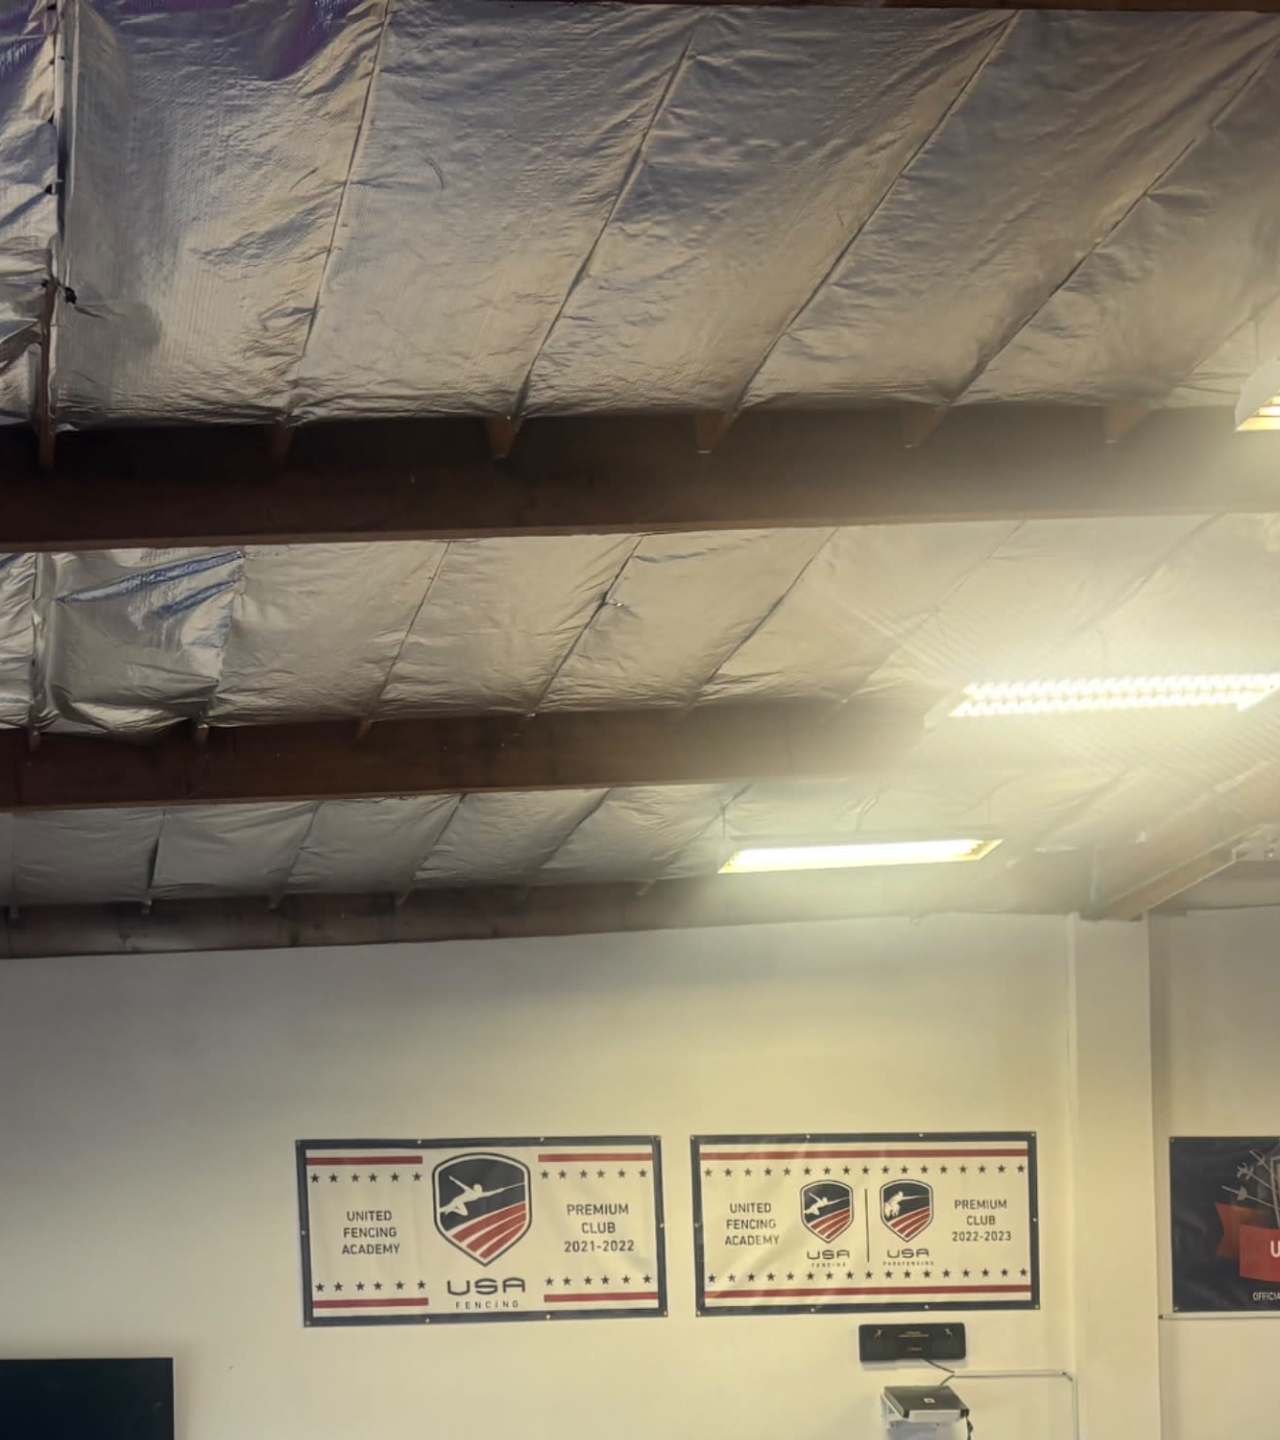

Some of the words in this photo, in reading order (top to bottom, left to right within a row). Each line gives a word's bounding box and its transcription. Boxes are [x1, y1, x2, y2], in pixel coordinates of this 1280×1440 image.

[567, 1204, 629, 1215] PREMIUM
[730, 1202, 772, 1214] UNITED
[954, 1199, 1007, 1210] PREMIUM
[346, 1210, 392, 1222] UNITED
[966, 1215, 996, 1226] CLUB
[581, 1222, 616, 1234] CLUB
[726, 1219, 776, 1230] FENCING
[343, 1227, 397, 1238] FENCING
[952, 1230, 1012, 1242] 2022-2023
[725, 1235, 780, 1246] ACADEMY
[342, 1243, 400, 1255] ACADEMY
[564, 1240, 635, 1253] 2021-2022
[807, 1249, 850, 1260] USA
[887, 1248, 930, 1259] USA
[447, 1277, 526, 1296] USA
[455, 1300, 519, 1310] FENCING
